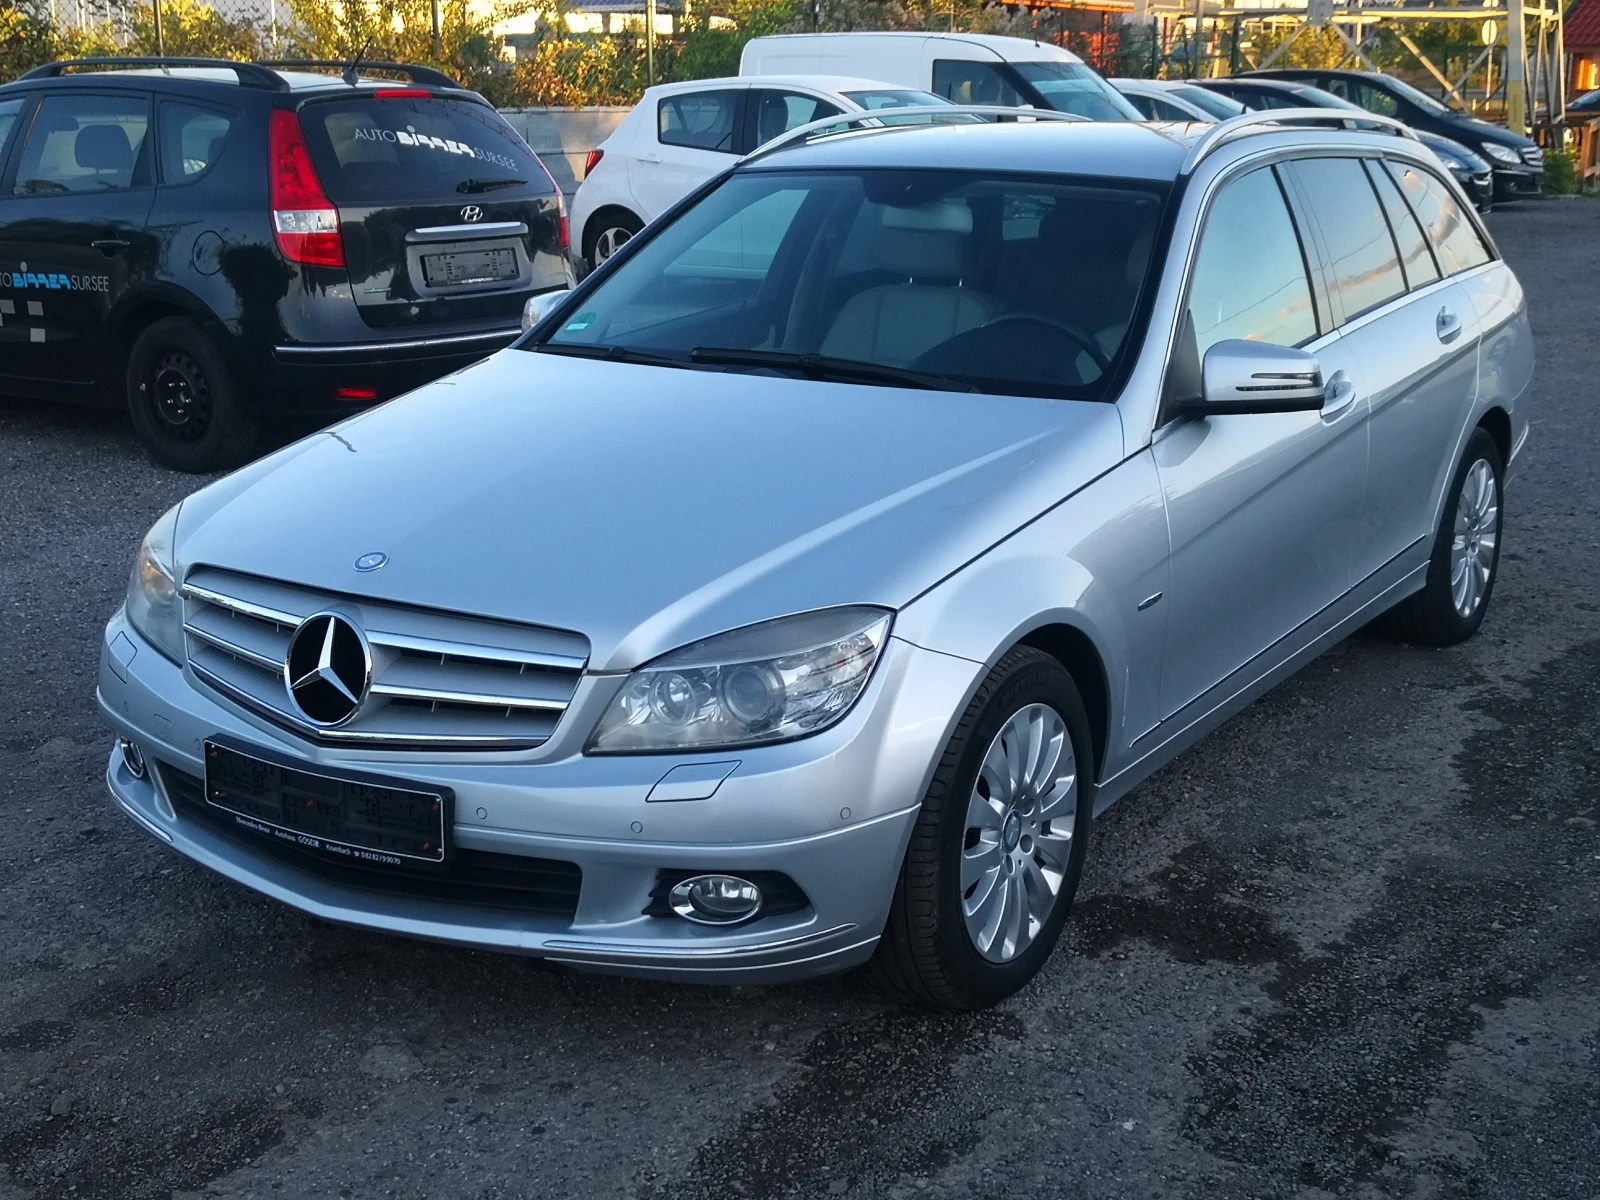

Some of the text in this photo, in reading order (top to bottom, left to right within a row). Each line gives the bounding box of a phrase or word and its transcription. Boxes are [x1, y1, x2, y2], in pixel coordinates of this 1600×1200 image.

[355, 128, 397, 143] AUTO
[475, 147, 518, 172] SURSEE
[71, 275, 109, 292] SURSEE
